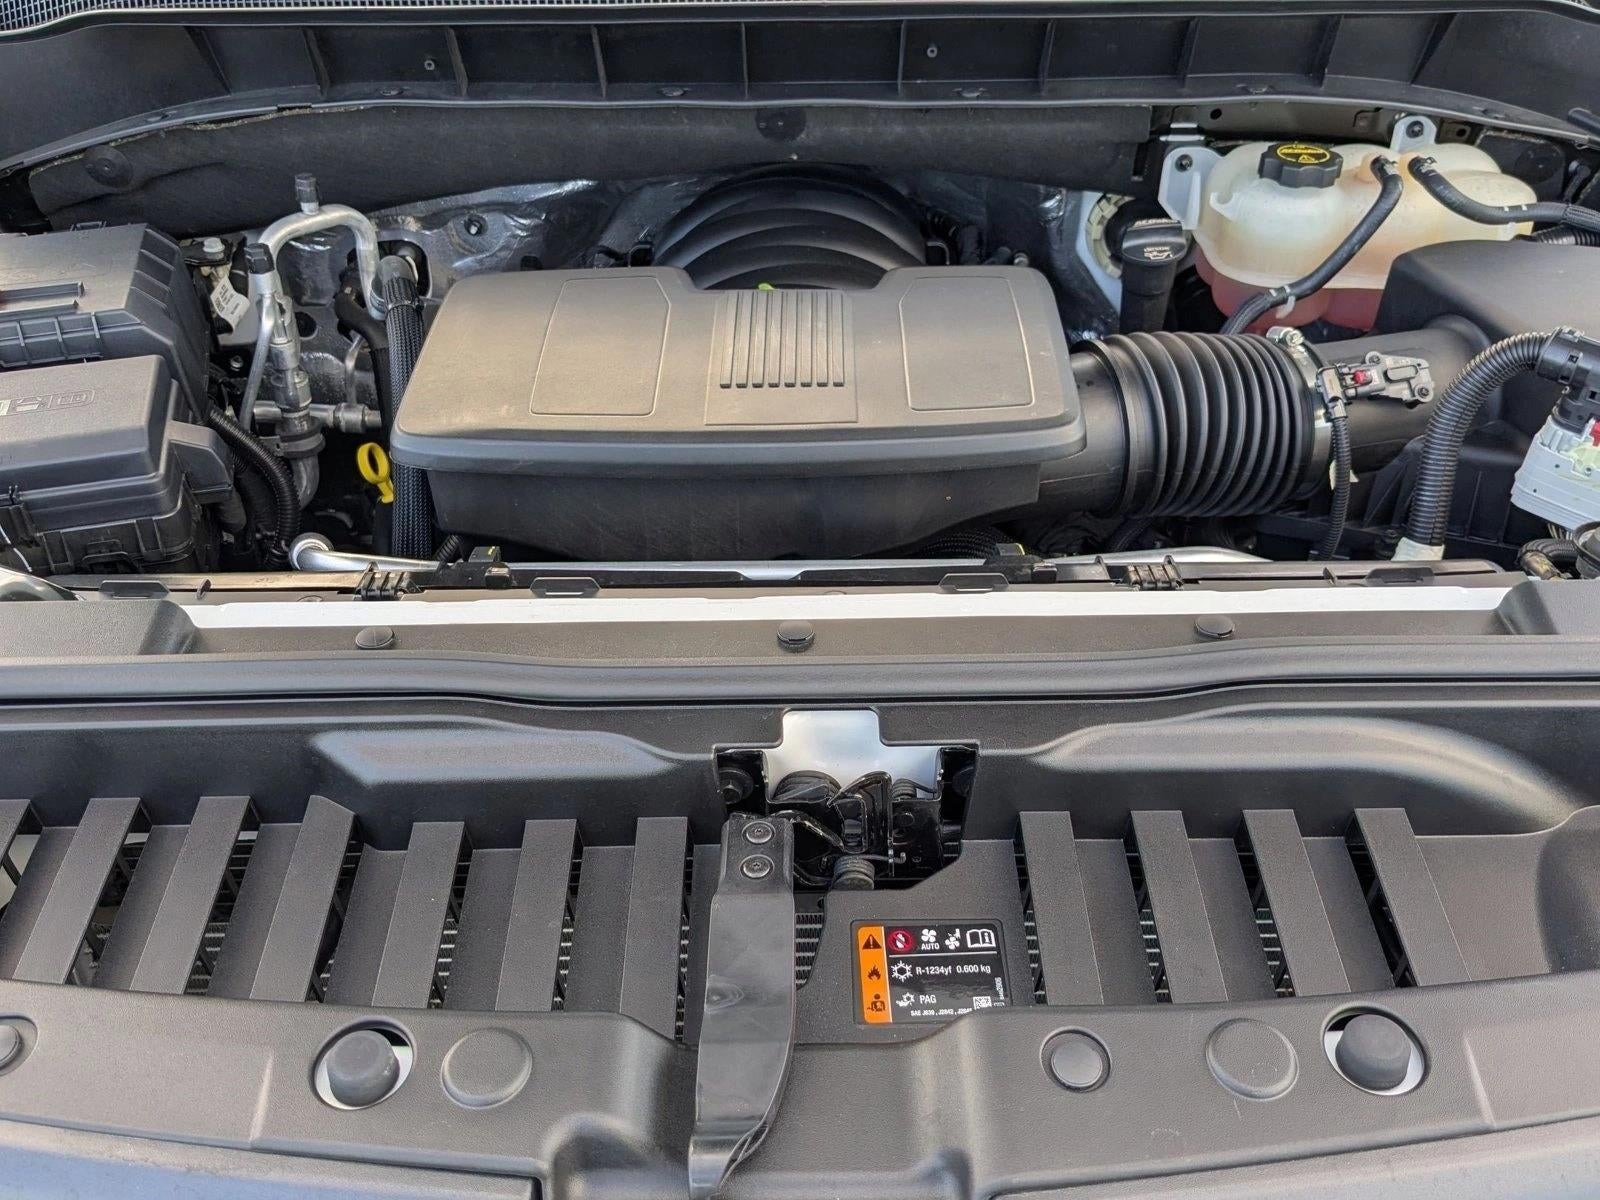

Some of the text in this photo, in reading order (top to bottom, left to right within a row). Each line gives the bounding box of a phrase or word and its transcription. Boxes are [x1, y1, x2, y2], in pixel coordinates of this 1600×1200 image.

[921, 942, 940, 951] AUTO
[915, 963, 991, 976] R-1234yf 0.600 kg
[919, 994, 937, 1005] PAG
[910, 1009, 921, 1017] SAE
